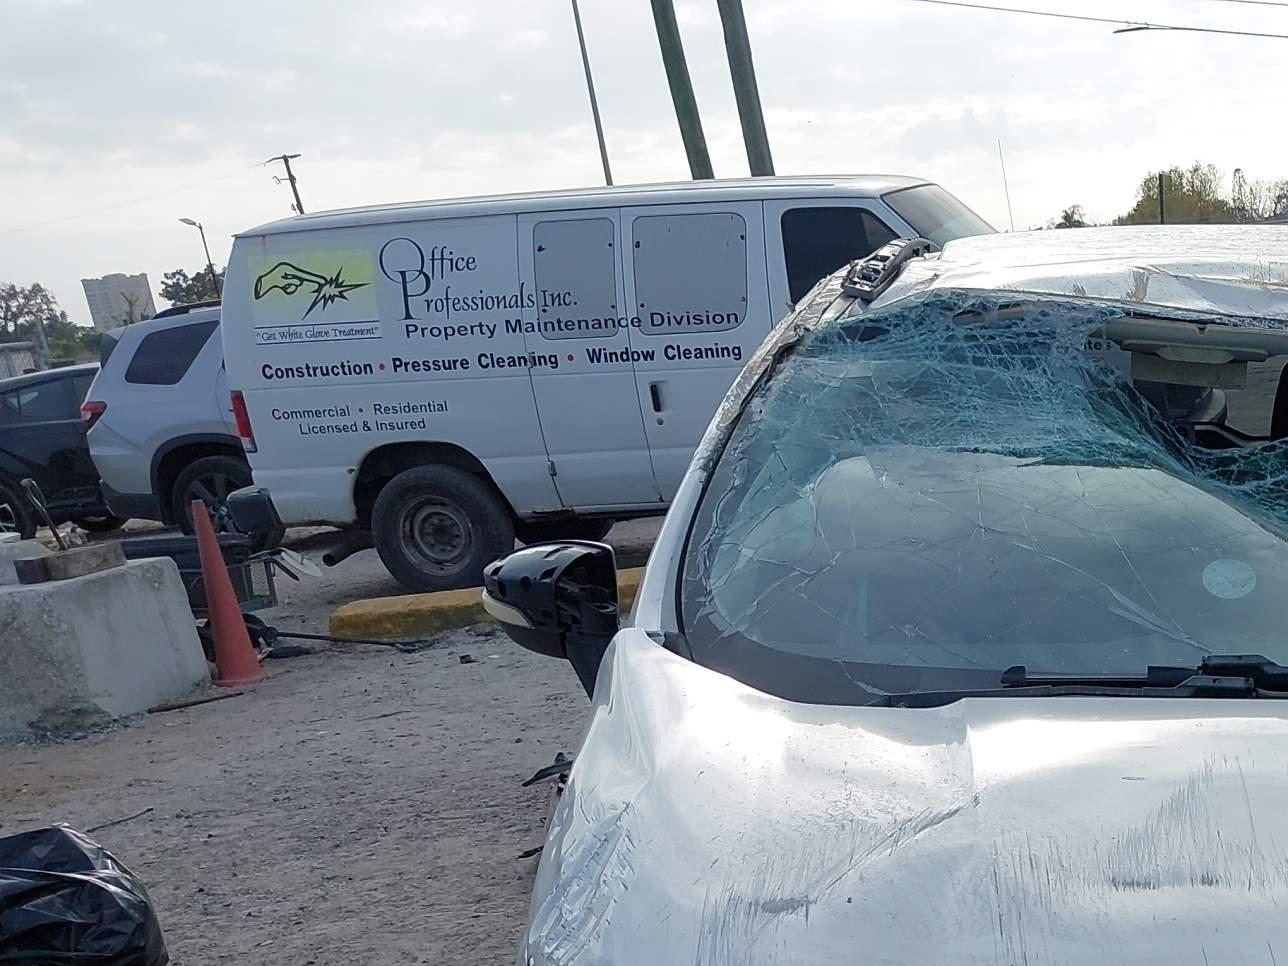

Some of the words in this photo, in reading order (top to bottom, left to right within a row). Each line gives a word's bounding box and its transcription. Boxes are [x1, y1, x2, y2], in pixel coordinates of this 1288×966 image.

[379, 238, 477, 284] Office
[395, 270, 535, 320] Professionals
[540, 289, 578, 307] Inc.
[280, 327, 303, 341] White
[304, 326, 331, 339] Glove
[405, 322, 497, 340] Property
[505, 316, 642, 334] Maintenance
[650, 310, 739, 328] Division
[261, 360, 374, 380] Construction
[392, 356, 470, 373] Pressure
[478, 351, 559, 370] Cleaning
[586, 346, 655, 364] Window
[664, 342, 742, 361] Cleaning
[271, 406, 351, 421] Commercial
[373, 400, 449, 416] Residential
[299, 420, 358, 435] Licensed
[362, 420, 372, 432] &
[375, 418, 426, 431] Insured
